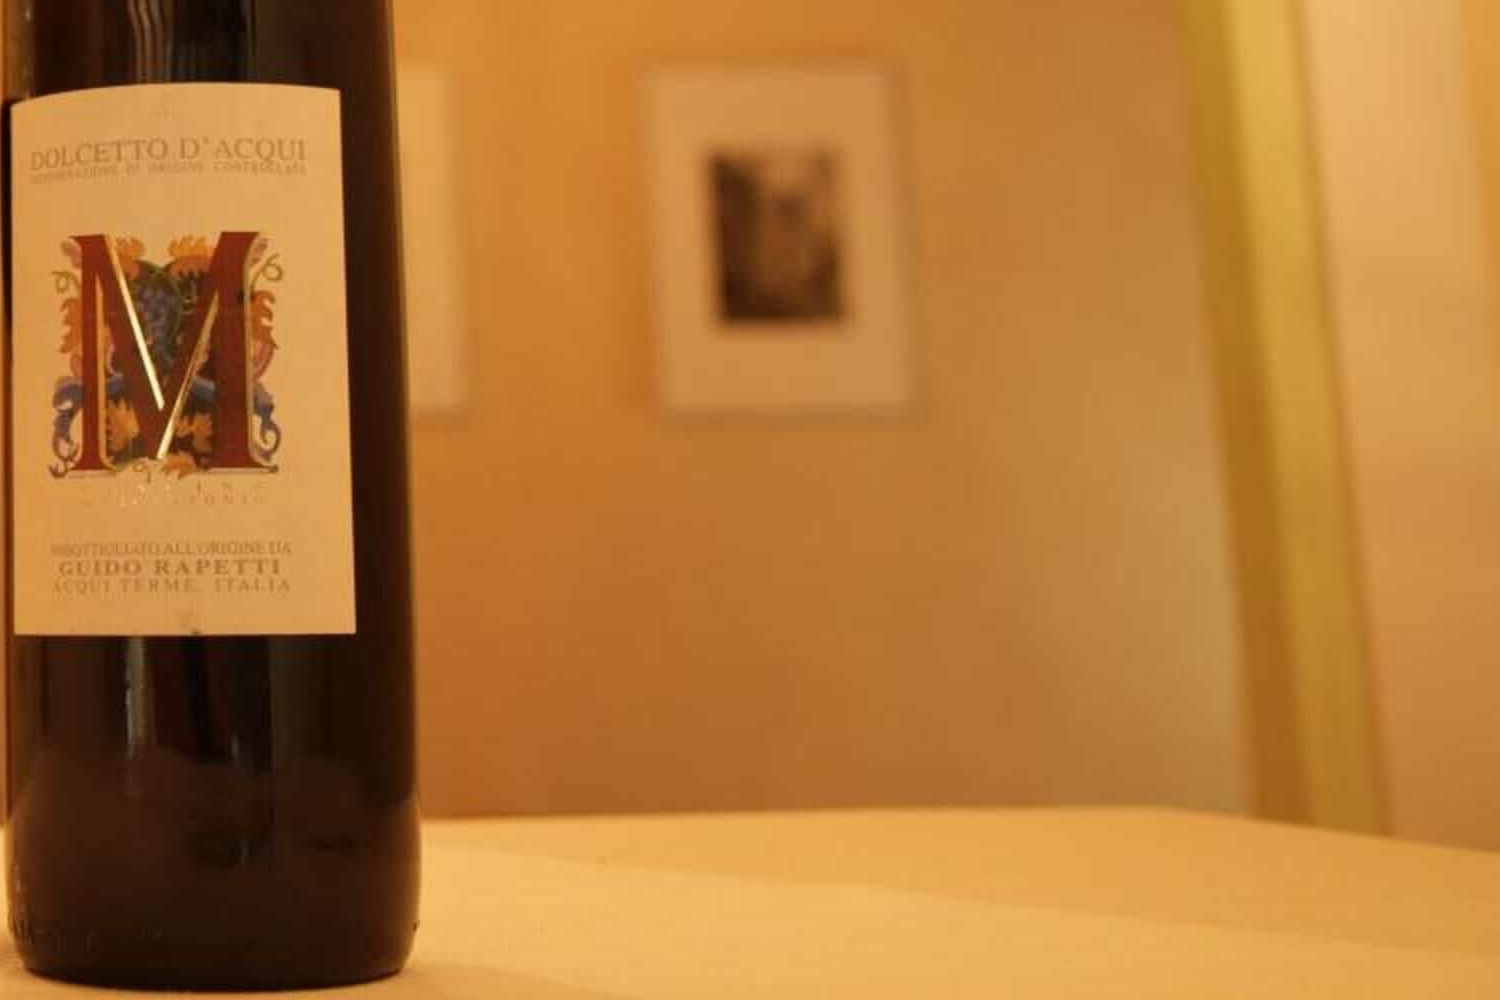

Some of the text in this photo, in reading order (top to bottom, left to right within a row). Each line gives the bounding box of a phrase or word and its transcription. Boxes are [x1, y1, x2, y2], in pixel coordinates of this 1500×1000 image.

[29, 136, 307, 171] DOLCETTO D'ACQUI
[66, 231, 268, 472] M
[59, 557, 280, 576] GUIDO RAPETTI
[214, 576, 291, 594] ITALIA
